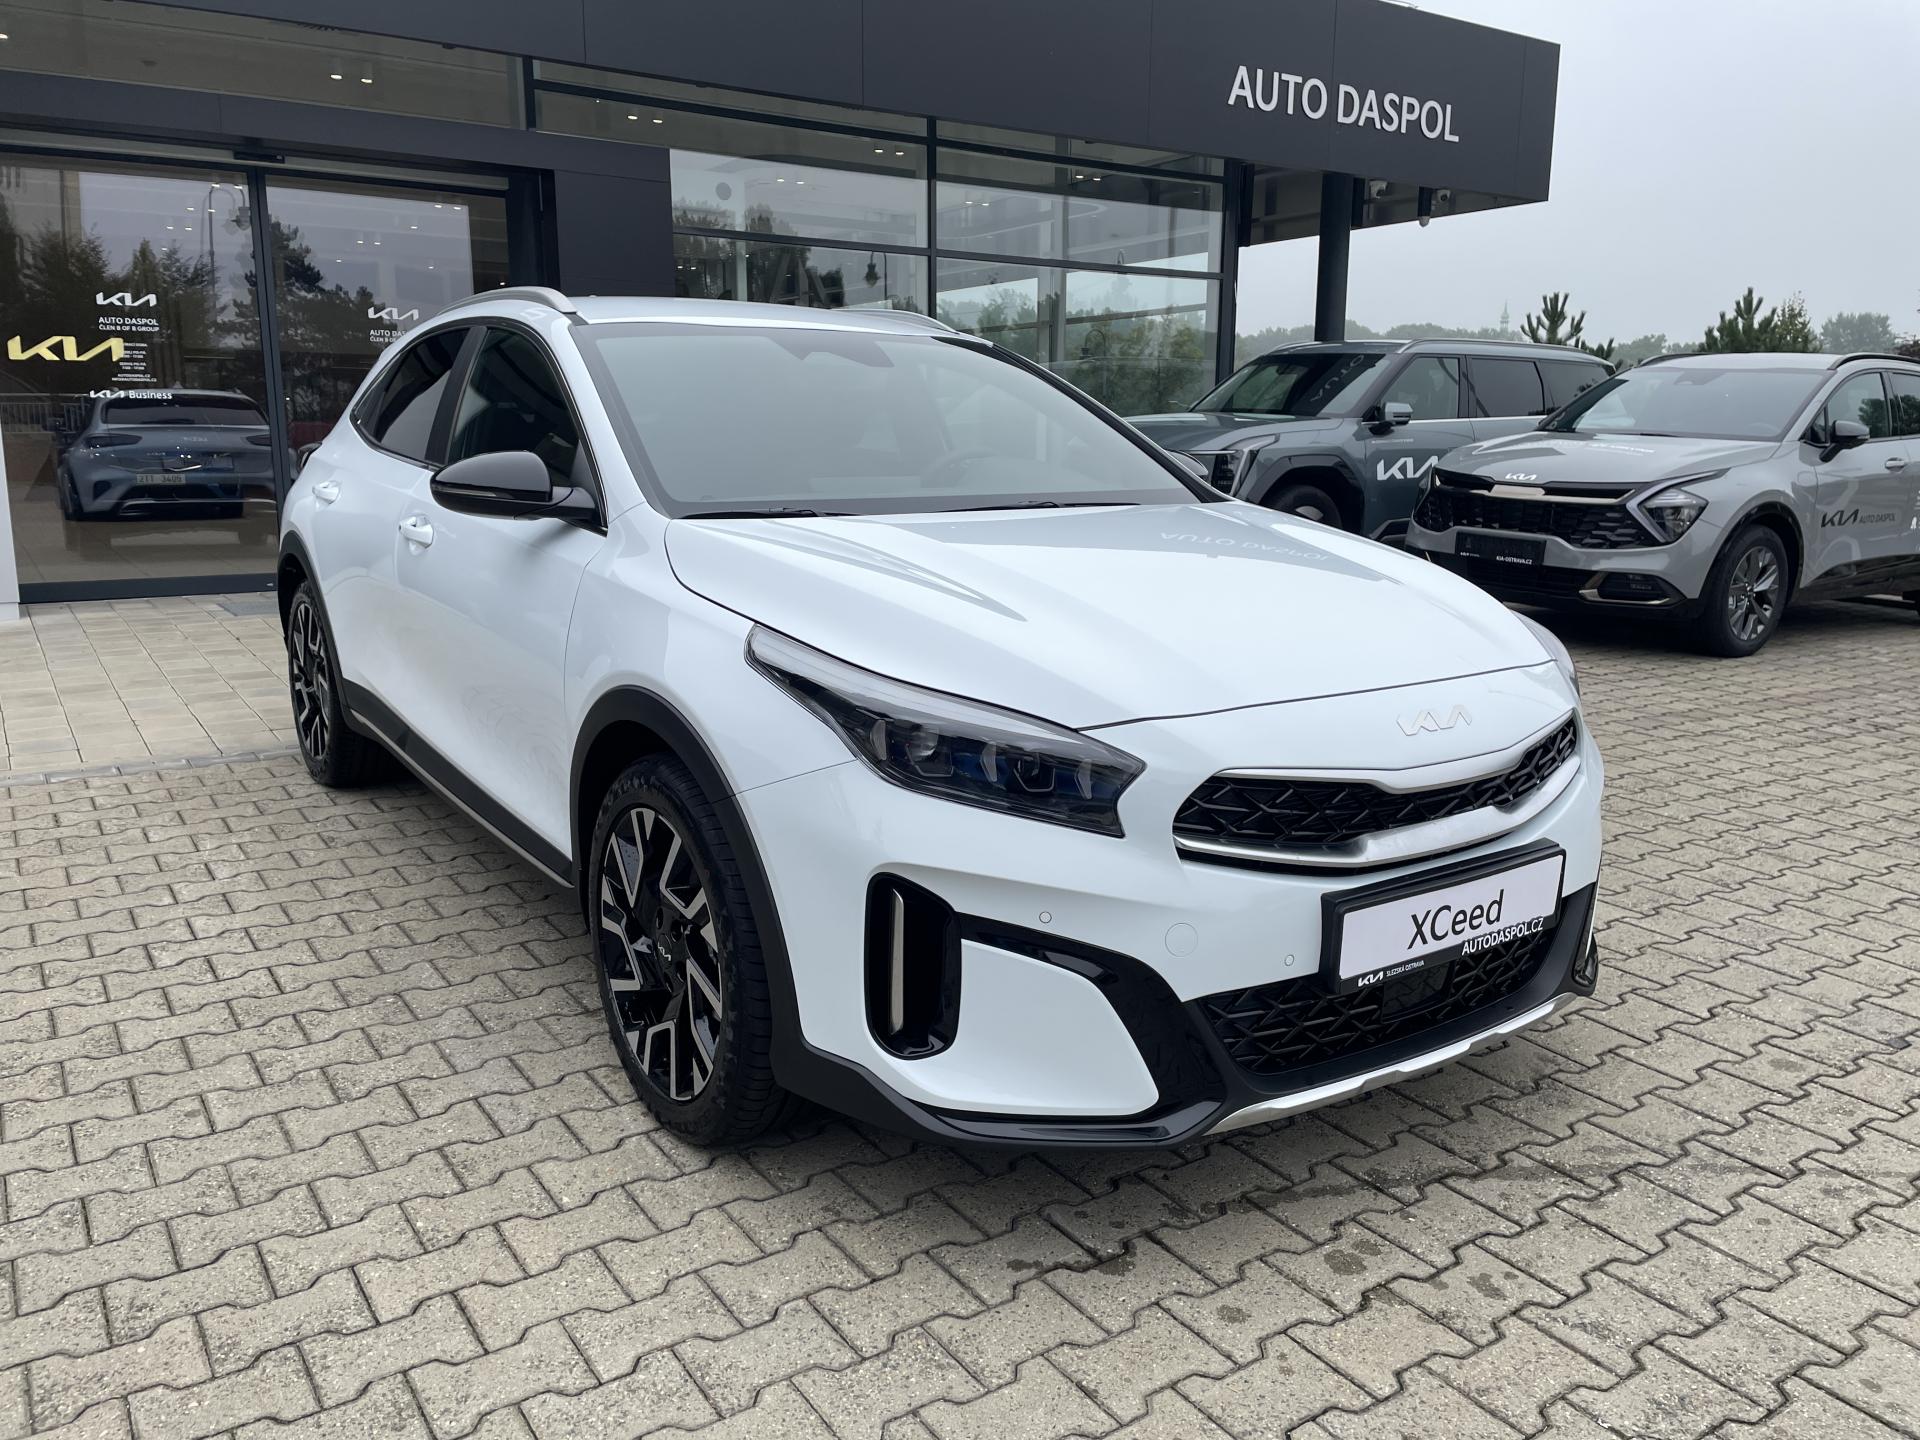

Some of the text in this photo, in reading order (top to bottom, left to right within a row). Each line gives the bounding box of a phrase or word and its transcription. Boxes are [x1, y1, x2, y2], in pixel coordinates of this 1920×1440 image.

[1227, 65, 1460, 143] AUTO DASPOL
[95, 291, 157, 307] KIA
[98, 317, 159, 326] AUTO DASPOL
[367, 306, 419, 321] KIA
[369, 329, 390, 337] AUTO
[7, 335, 125, 362] KIA
[128, 390, 173, 400] Business
[1820, 508, 1860, 529] KIA
[1407, 888, 1505, 950] XCeed
[1461, 917, 1544, 956] AUTODASPOL.CZ
[1357, 970, 1384, 987] KIA
[1404, 960, 1425, 971] OSTRAVA
